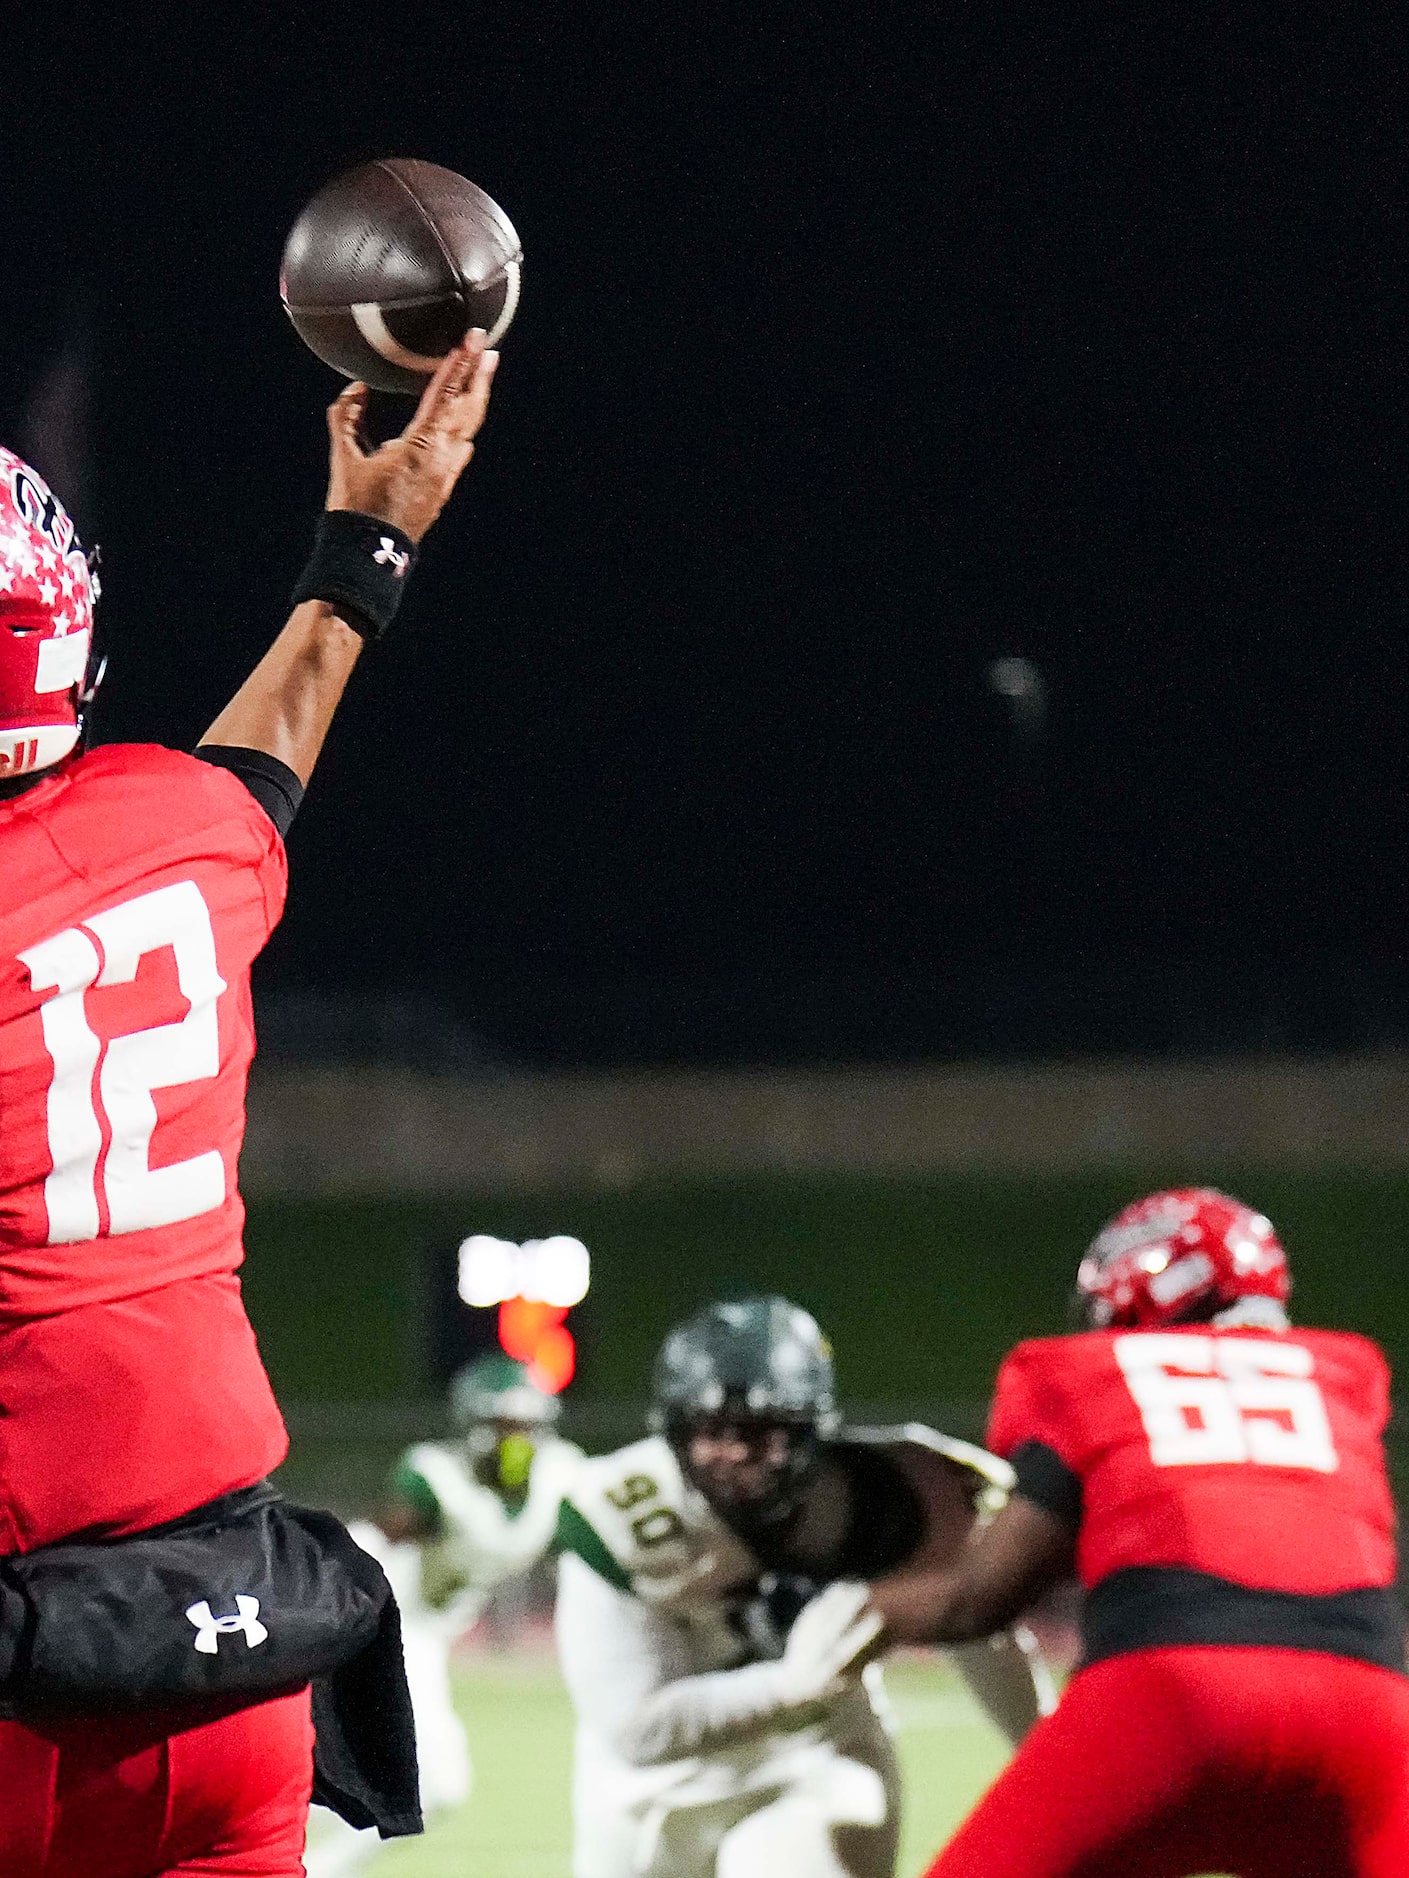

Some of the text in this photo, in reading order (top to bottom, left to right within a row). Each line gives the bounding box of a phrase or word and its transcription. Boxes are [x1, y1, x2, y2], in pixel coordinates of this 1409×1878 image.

[15, 879, 228, 1245] 12
[1112, 1333, 1340, 1474] 65
[604, 1473, 683, 1549] 90
